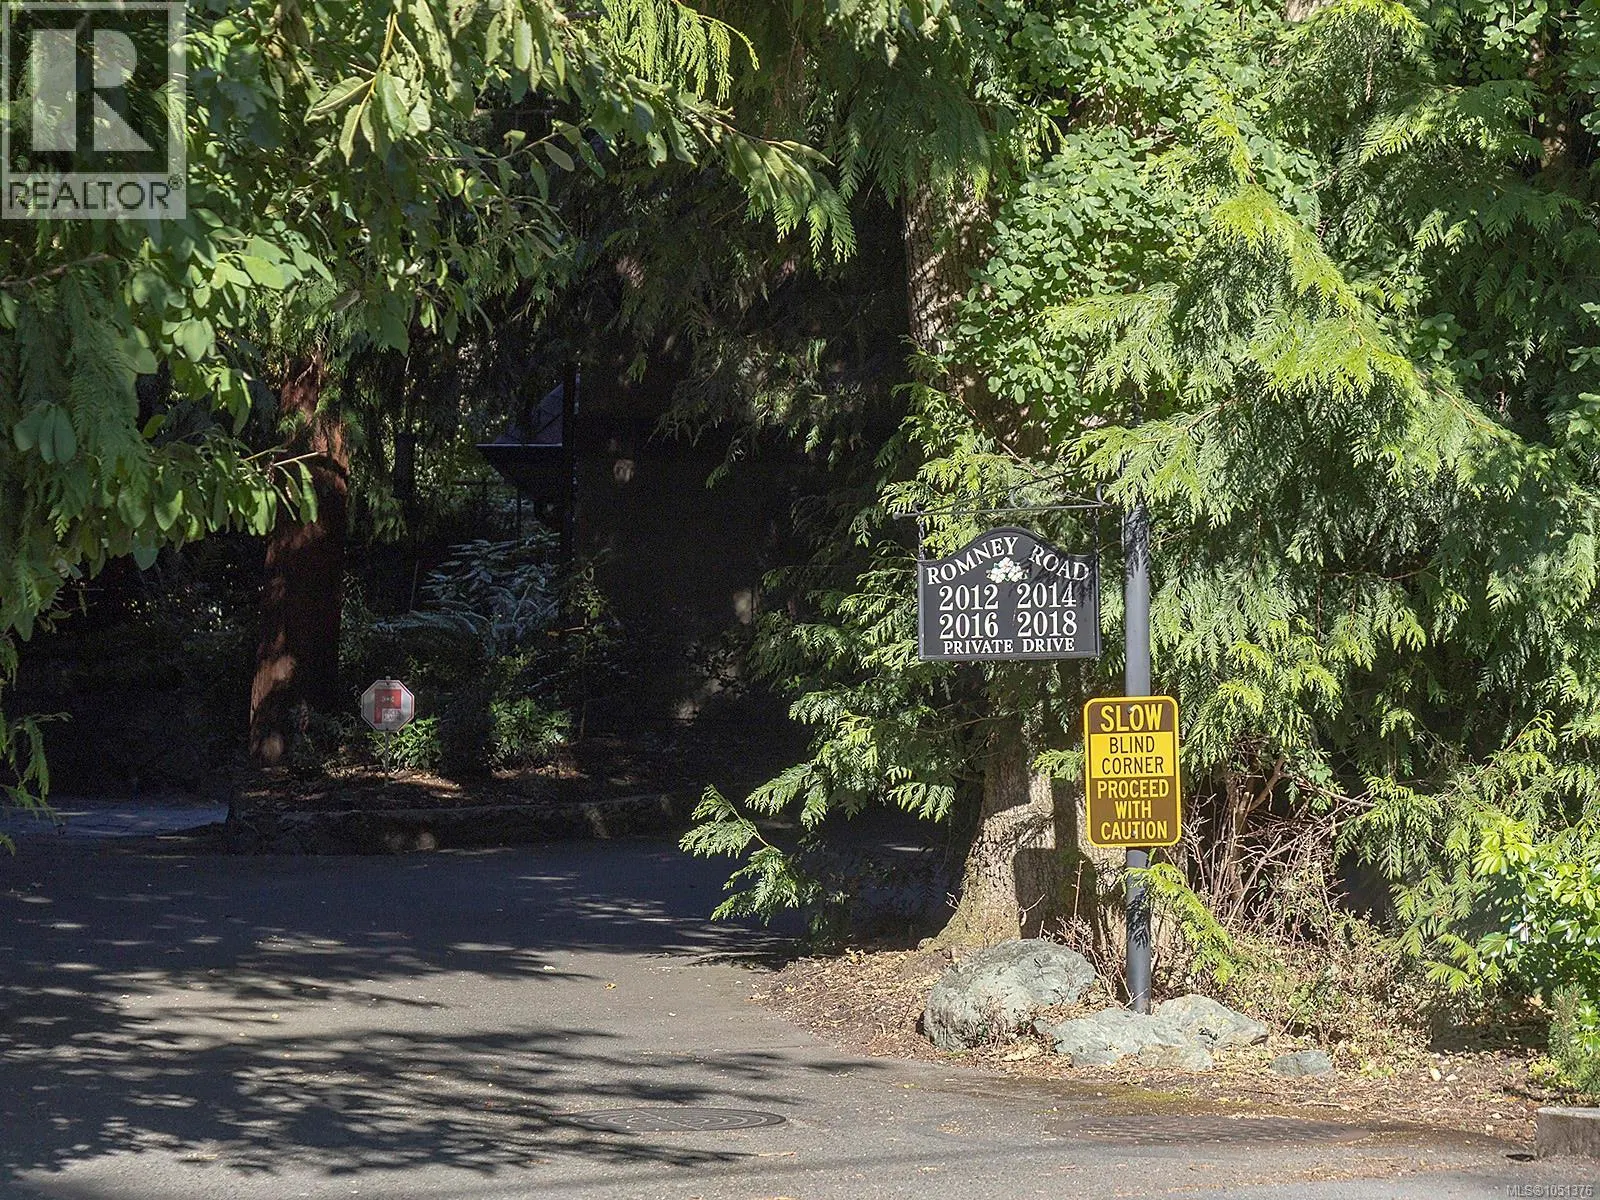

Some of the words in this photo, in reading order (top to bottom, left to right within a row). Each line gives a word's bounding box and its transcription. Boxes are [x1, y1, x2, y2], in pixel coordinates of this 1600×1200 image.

[926, 536, 1019, 585] ROMNEY
[1028, 543, 1090, 581] ROAD
[939, 584, 999, 611] 2012
[1016, 582, 1076, 609] 2014
[939, 612, 999, 640] 2016
[1017, 610, 1077, 637] 2018
[943, 639, 1014, 654] PRIVATE
[1022, 637, 1075, 653] DRIVE
[1100, 703, 1163, 732] SLOW
[1109, 735, 1155, 754] BLIND
[1101, 756, 1164, 775] CORNER
[1097, 779, 1170, 799] PROCEED
[1115, 800, 1152, 819] WITH
[1100, 820, 1168, 841] CAUTION
